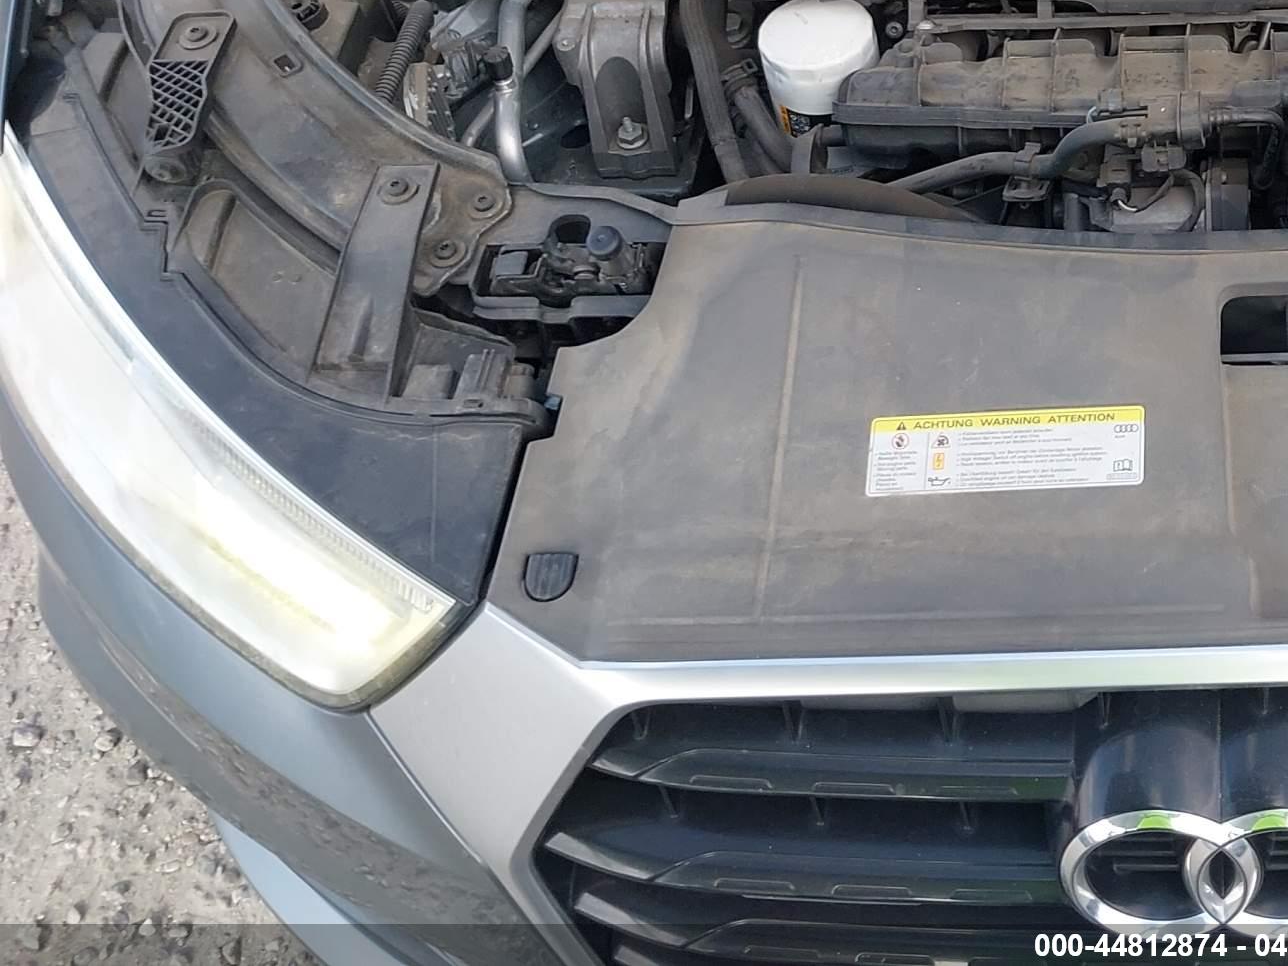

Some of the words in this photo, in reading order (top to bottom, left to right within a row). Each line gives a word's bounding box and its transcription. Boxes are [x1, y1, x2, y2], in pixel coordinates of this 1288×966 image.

[913, 419, 973, 430] ACHTUNG
[980, 416, 1042, 427] WARNING
[1048, 413, 1115, 423] ATTENTION
